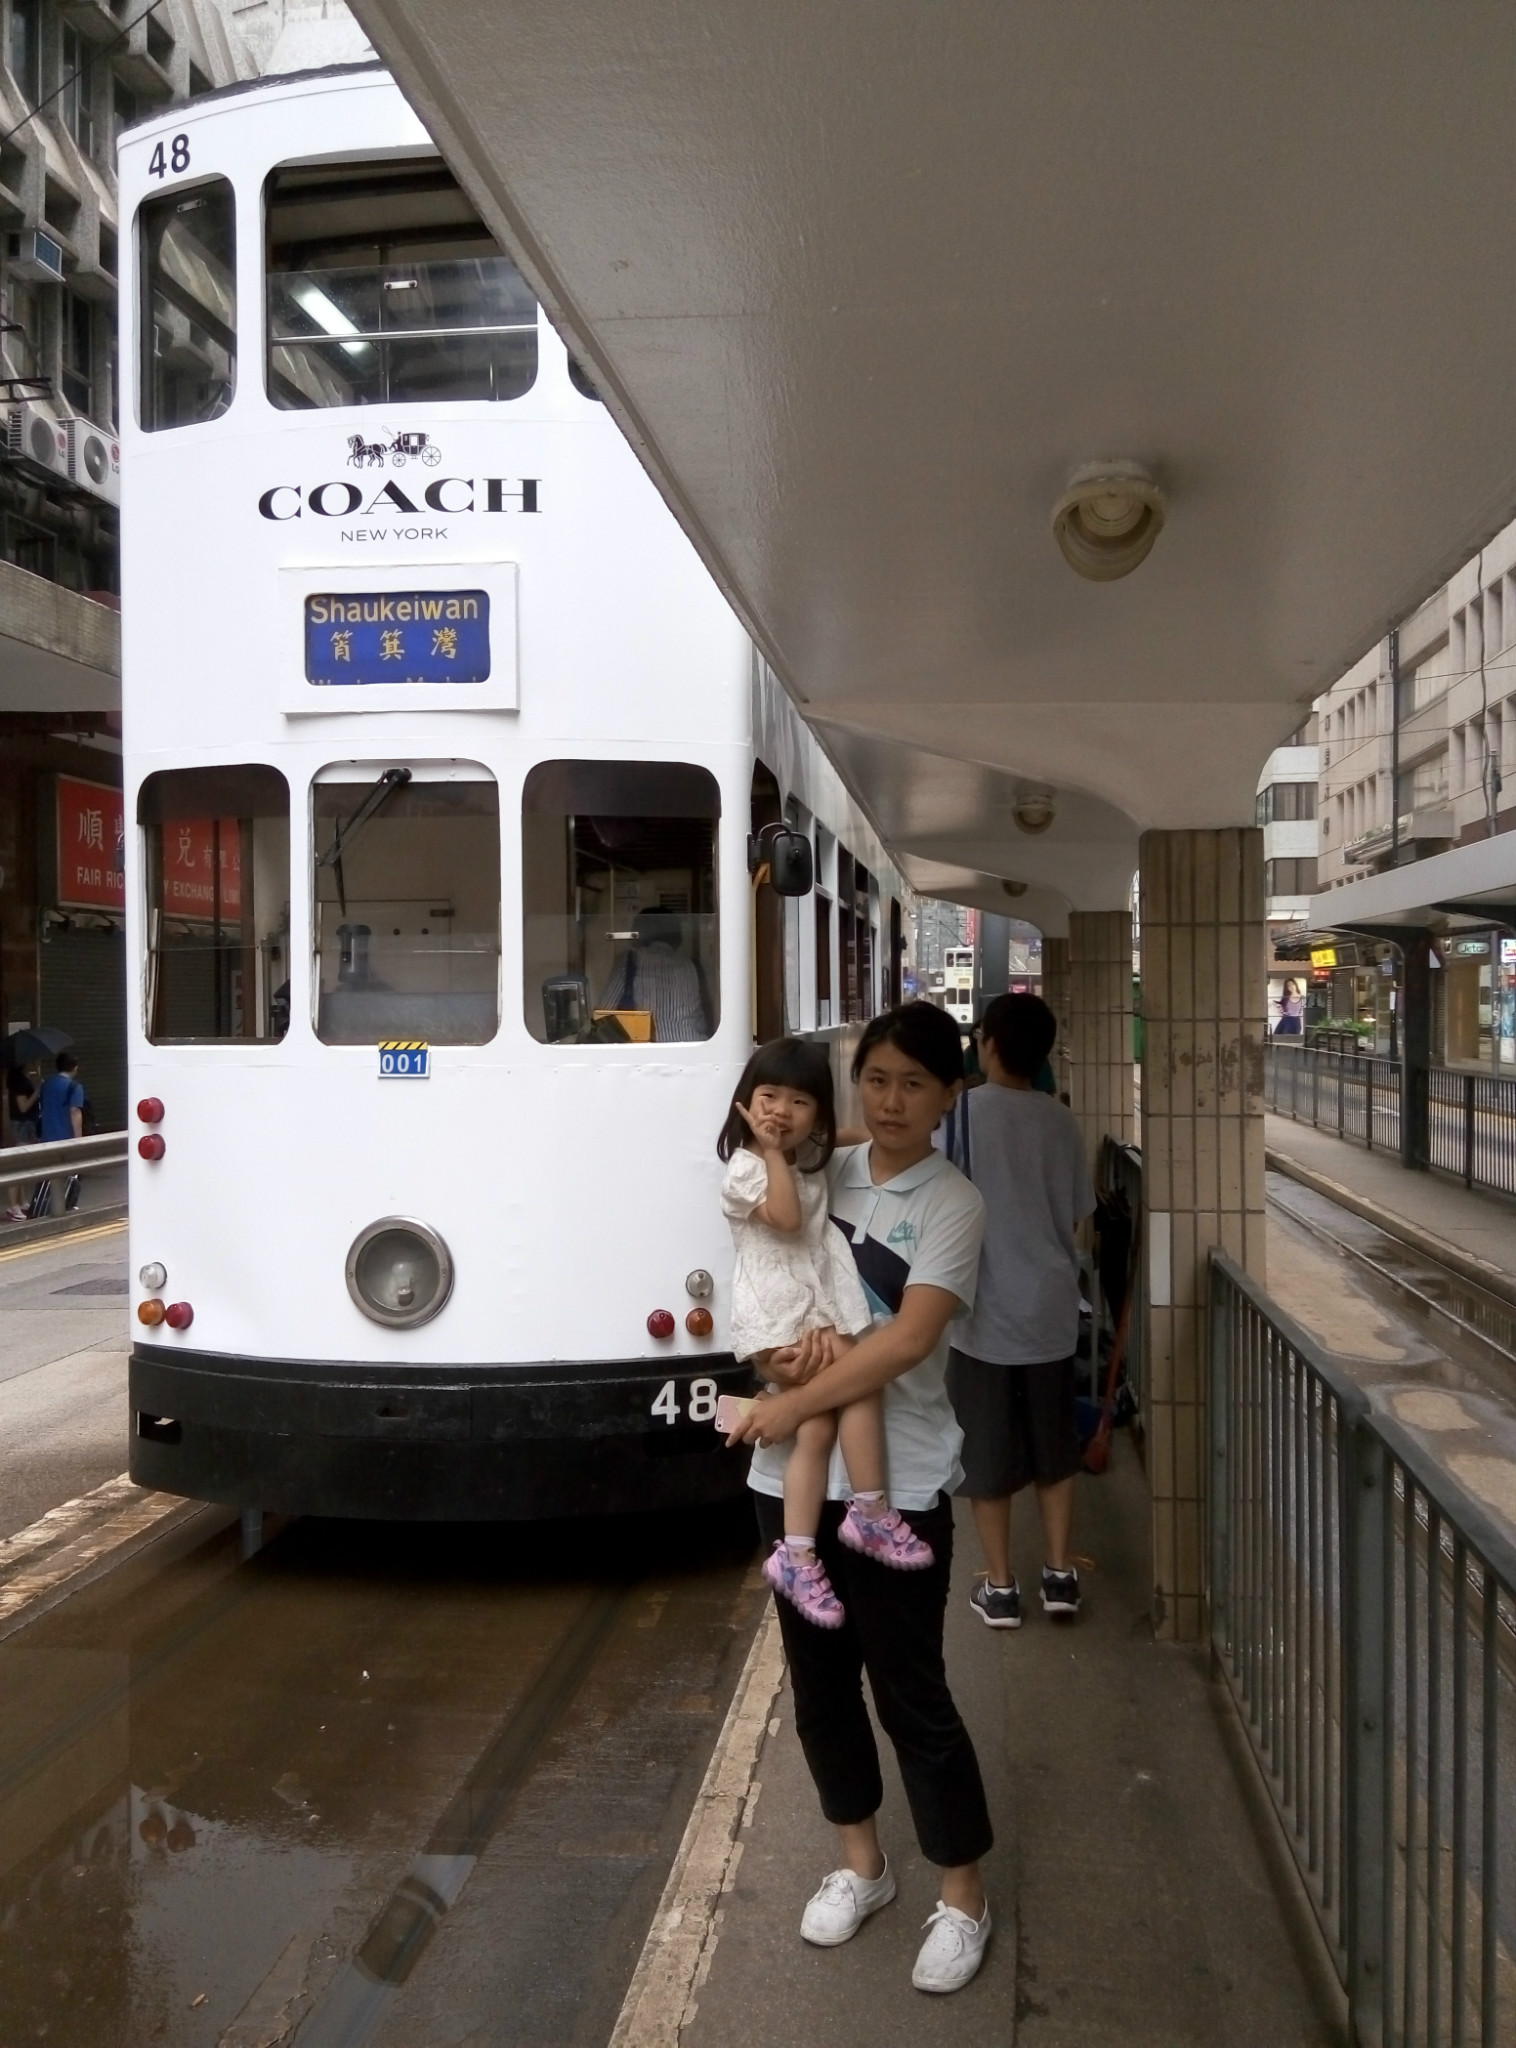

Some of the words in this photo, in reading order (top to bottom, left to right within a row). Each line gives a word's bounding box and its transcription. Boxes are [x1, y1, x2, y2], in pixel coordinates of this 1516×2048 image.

[148, 133, 191, 179] 48
[258, 477, 543, 521] COACH
[341, 529, 388, 542] NEW
[392, 527, 448, 540] YORK
[310, 595, 478, 624] Shaukeiwan
[330, 626, 458, 663] 筲箕灣
[77, 866, 102, 886] FAIR
[106, 870, 125, 890] RIC
[173, 880, 214, 903] EXCHANG
[381, 1053, 422, 1074] 001
[650, 1377, 718, 1426] 48
